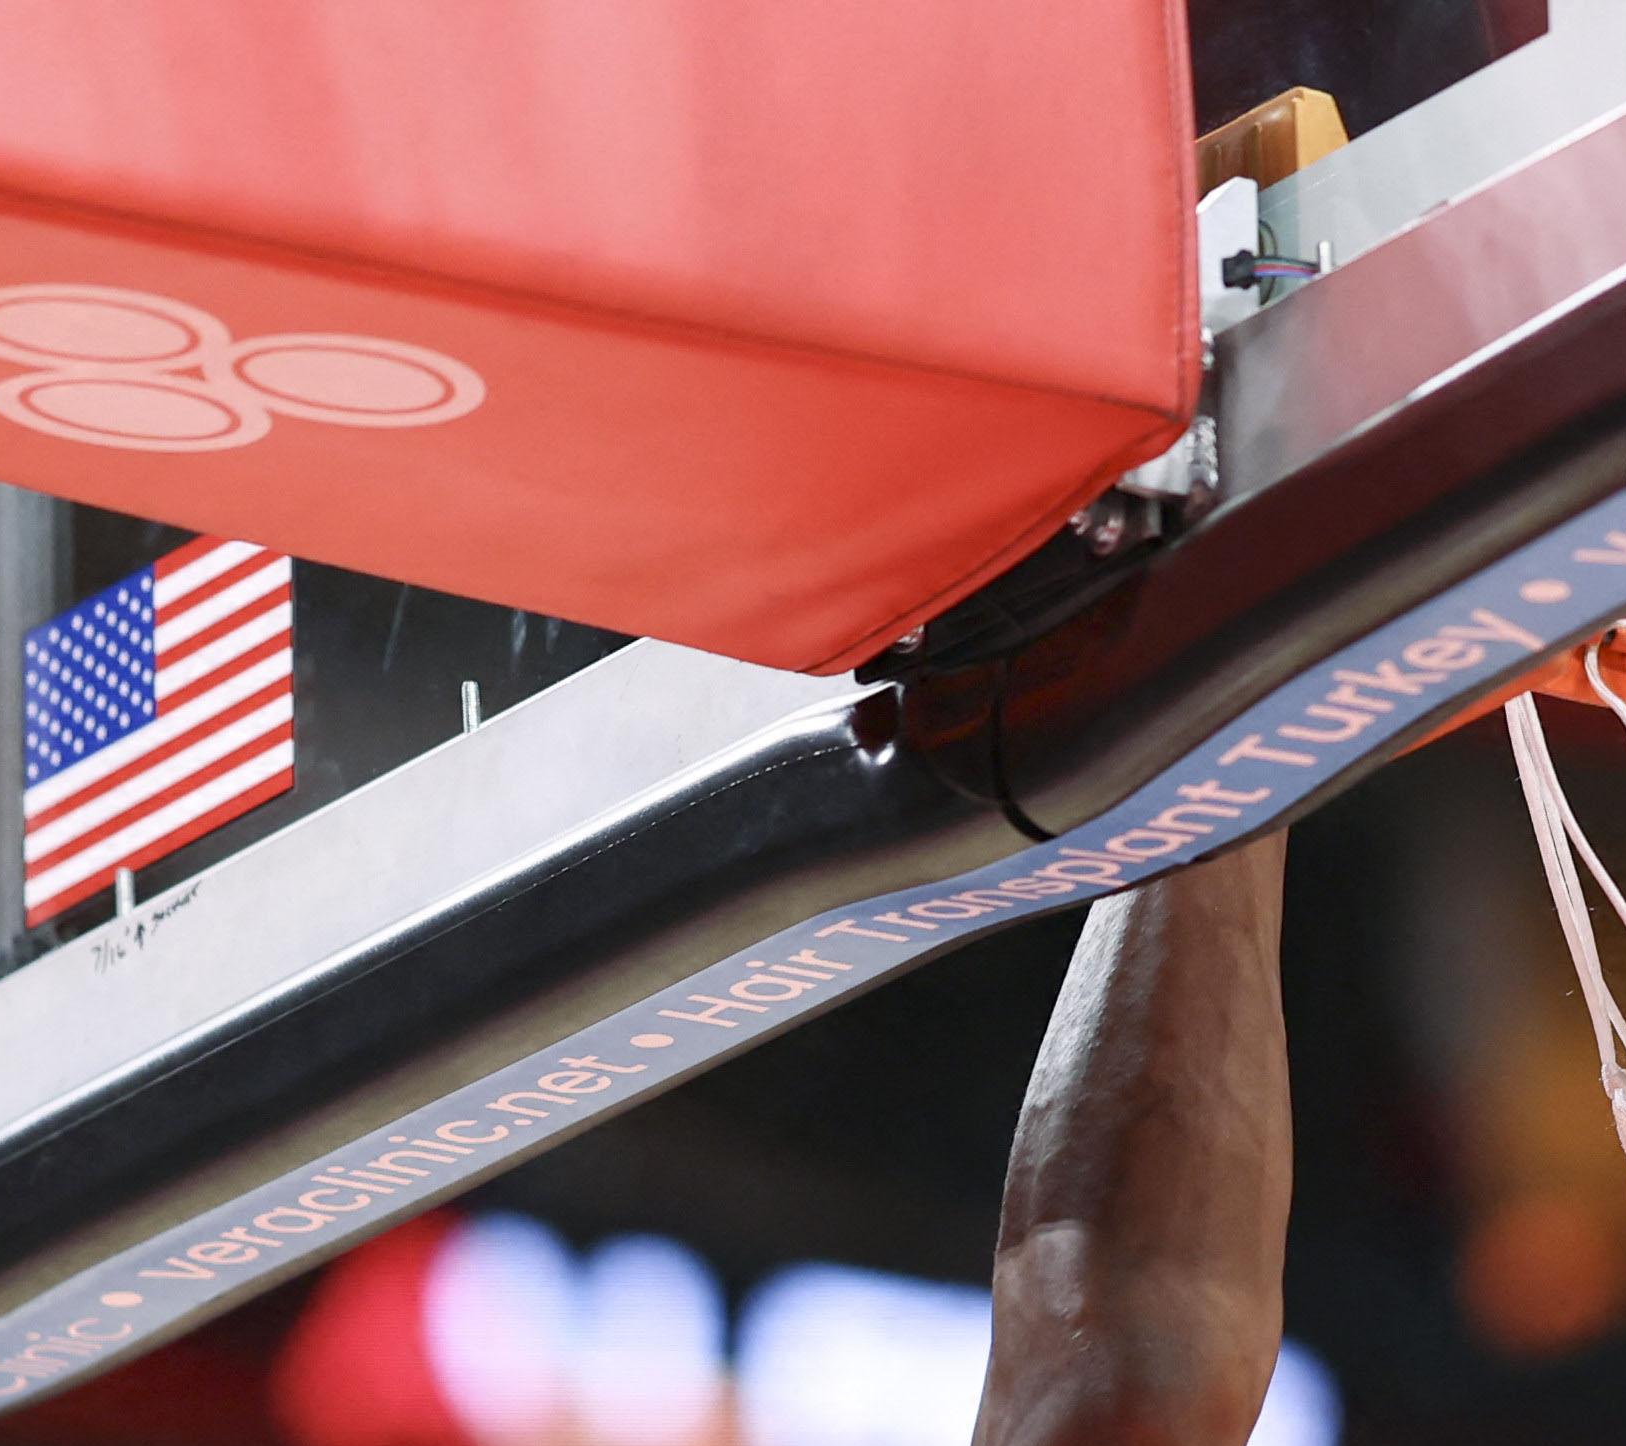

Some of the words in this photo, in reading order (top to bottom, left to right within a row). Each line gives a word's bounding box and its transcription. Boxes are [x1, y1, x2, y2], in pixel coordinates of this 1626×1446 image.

[138, 1054, 649, 1280] veraclinic.net
[658, 949, 854, 1028] Hair
[815, 780, 1271, 942] Transplant
[1218, 608, 1547, 767] Turkey
